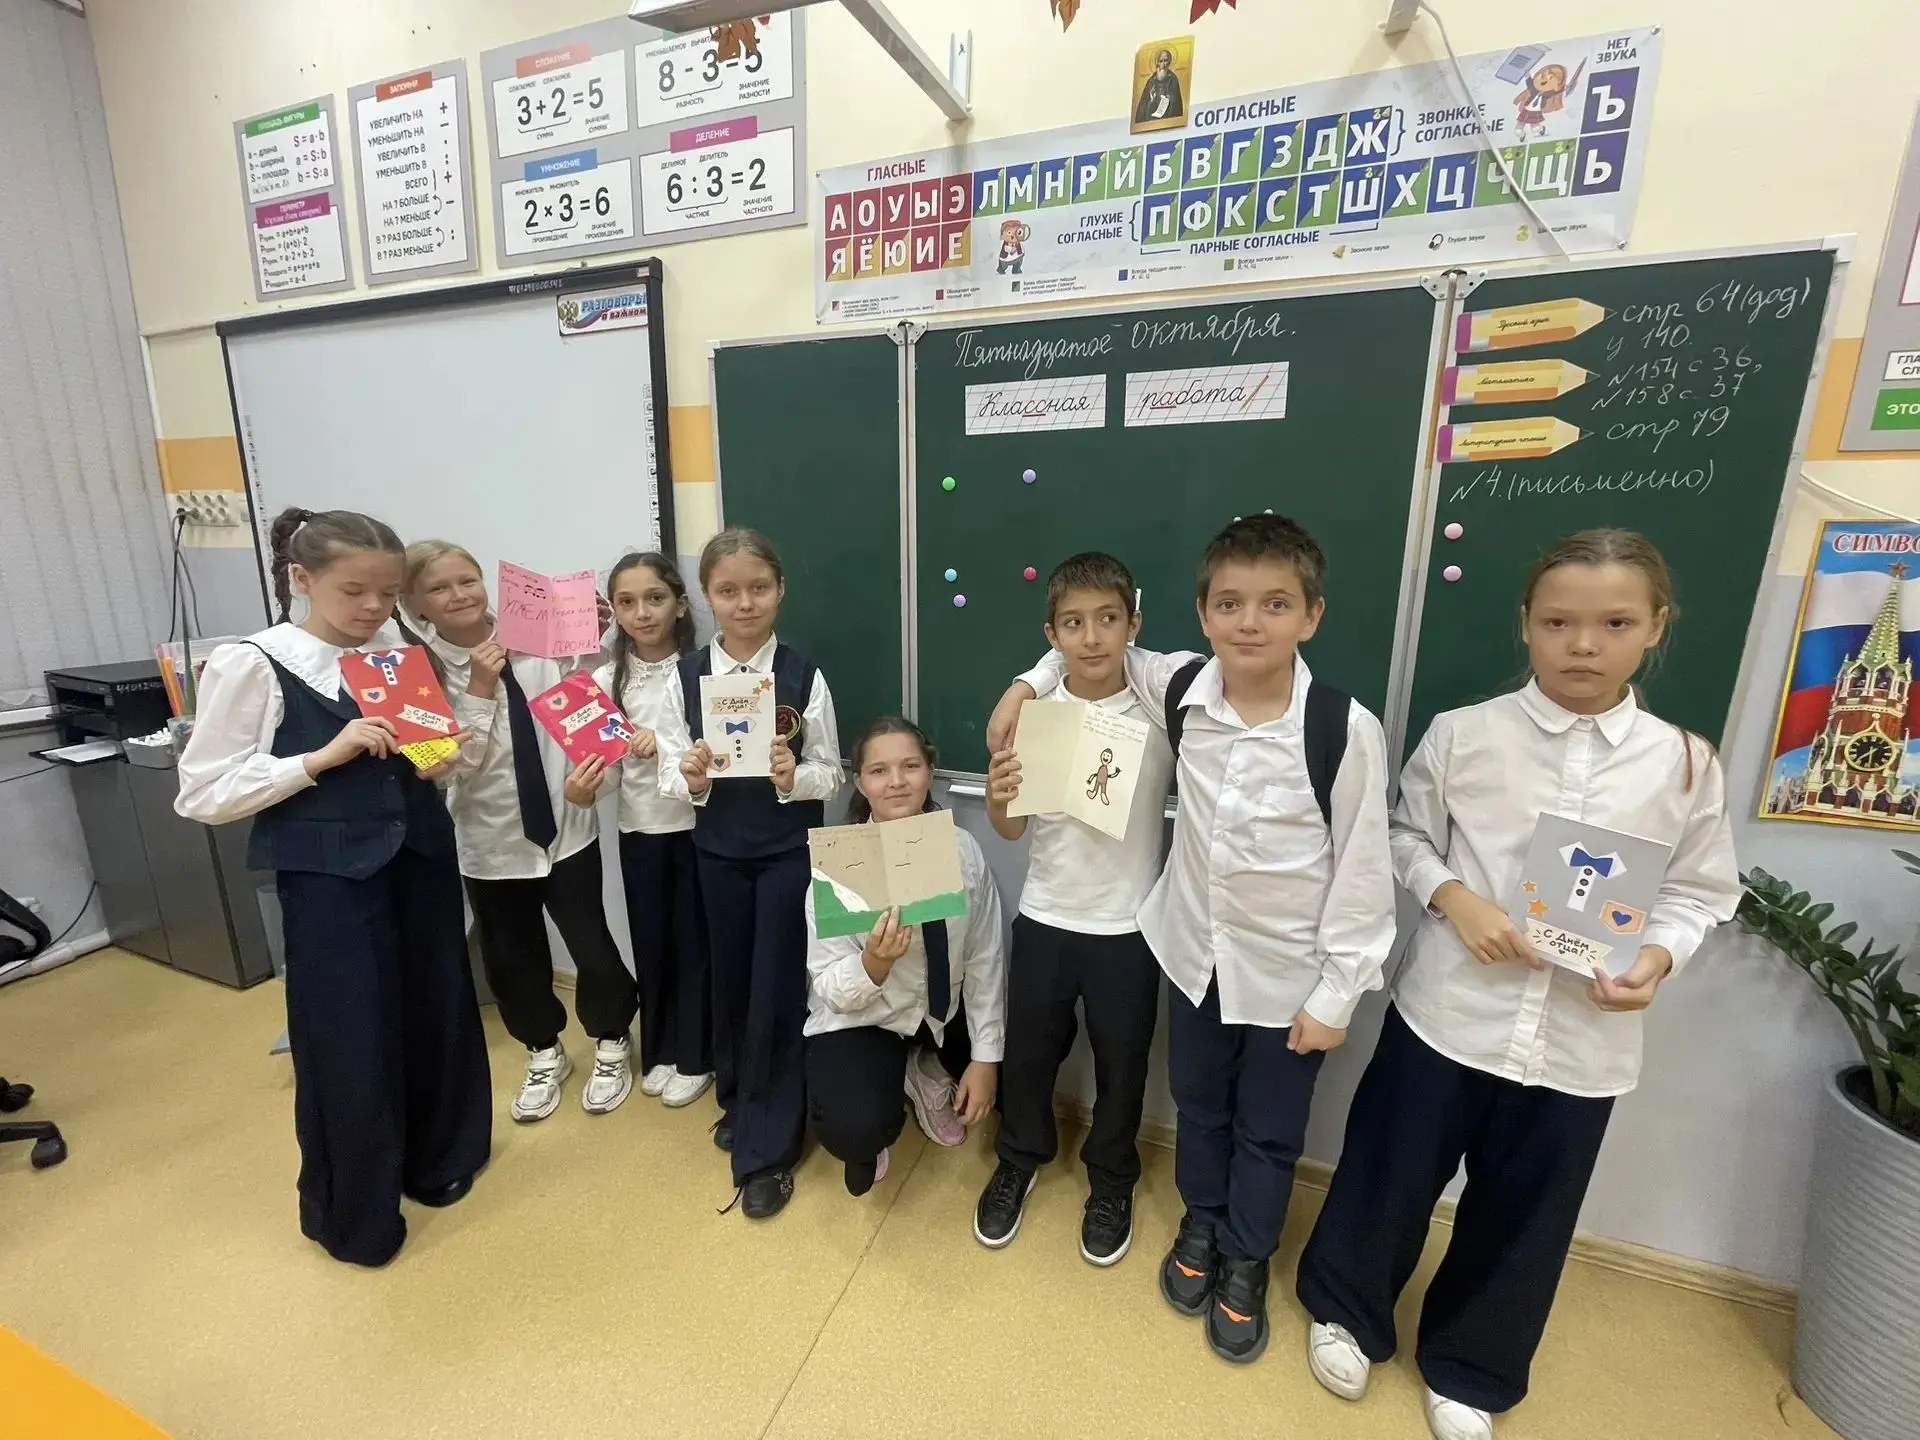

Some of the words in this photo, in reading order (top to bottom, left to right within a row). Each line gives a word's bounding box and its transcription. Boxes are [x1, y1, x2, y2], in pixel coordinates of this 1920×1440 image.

[1607, 37, 1631, 50] НЕТ
[1595, 48, 1637, 64] ЗВУКА
[738, 78, 770, 91] ЗНАЧЕНИЕ
[738, 88, 771, 101] РАЗНОСТИ
[369, 112, 411, 130] УВЕЛИЧИТЬ
[412, 109, 423, 120] НА
[1194, 96, 1296, 128] СОГЛАСНЫЕ
[368, 129, 412, 147] УМЕНЬШИТЬ
[413, 126, 425, 137] НА
[695, 128, 730, 144] ДЕЛЕНИЕ
[377, 145, 419, 162] УВЕЛИЧИТЬ
[699, 151, 729, 163] ДЕЛИТЕЛЬ
[376, 162, 420, 179] УМЕНЬШИТЬ
[660, 158, 687, 170] ДЕЛИМОЕ
[867, 159, 926, 182] ГЛАСНЫЕ
[405, 177, 428, 190] ВСЕГО
[400, 193, 430, 208] БОЛЬШЕ
[742, 195, 773, 207] ЗНАЧЕНИЕ
[400, 210, 431, 223] МЕНЬШЕ
[685, 210, 710, 220] ЧАСТНОЕ
[742, 205, 774, 217] ЧАСТНОГО
[1080, 212, 1124, 228] ГЛУХИЕ
[388, 232, 401, 243] РАЗ
[402, 227, 432, 240] БОЛЬШЕ
[1057, 226, 1123, 245] СОГЛАСНЫЕ
[1190, 238, 1240, 255] ПАРНЫЕ
[1243, 230, 1320, 250] СОГЛАСНЫЕ
[388, 248, 402, 259] РАЗ
[403, 243, 434, 256] МЕНЬШЕ
[581, 292, 647, 312] РАЗГОВОРЫ
[954, 329, 1114, 380] Пятнадцатое
[978, 390, 1091, 418] Классная
[1137, 378, 1247, 418] работа
[1692, 405, 1730, 437] 79
[1543, 929, 1554, 938] С
[1555, 932, 1589, 950] Днём
[1549, 940, 1585, 956] отца!
